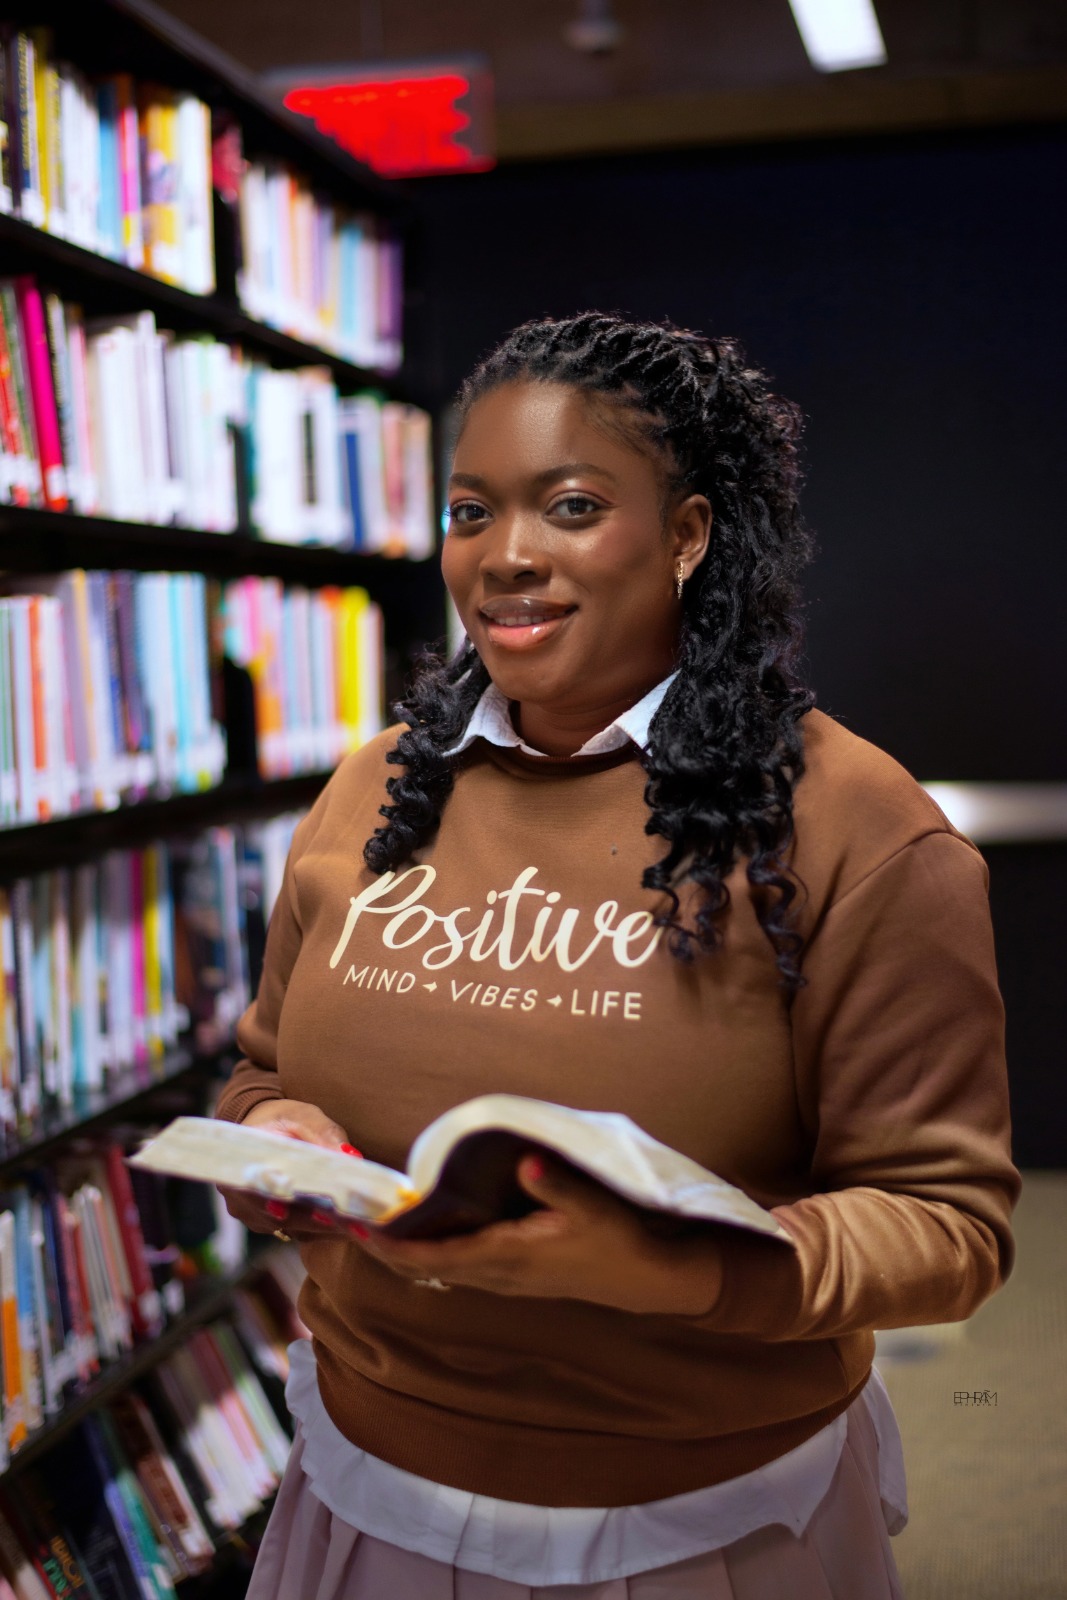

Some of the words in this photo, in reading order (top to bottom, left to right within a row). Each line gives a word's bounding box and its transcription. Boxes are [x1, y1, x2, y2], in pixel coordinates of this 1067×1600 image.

[329, 864, 663, 972] Positive
[343, 964, 416, 994] MIND
[451, 980, 539, 1011] VIBES
[571, 989, 642, 1020] LIFE
